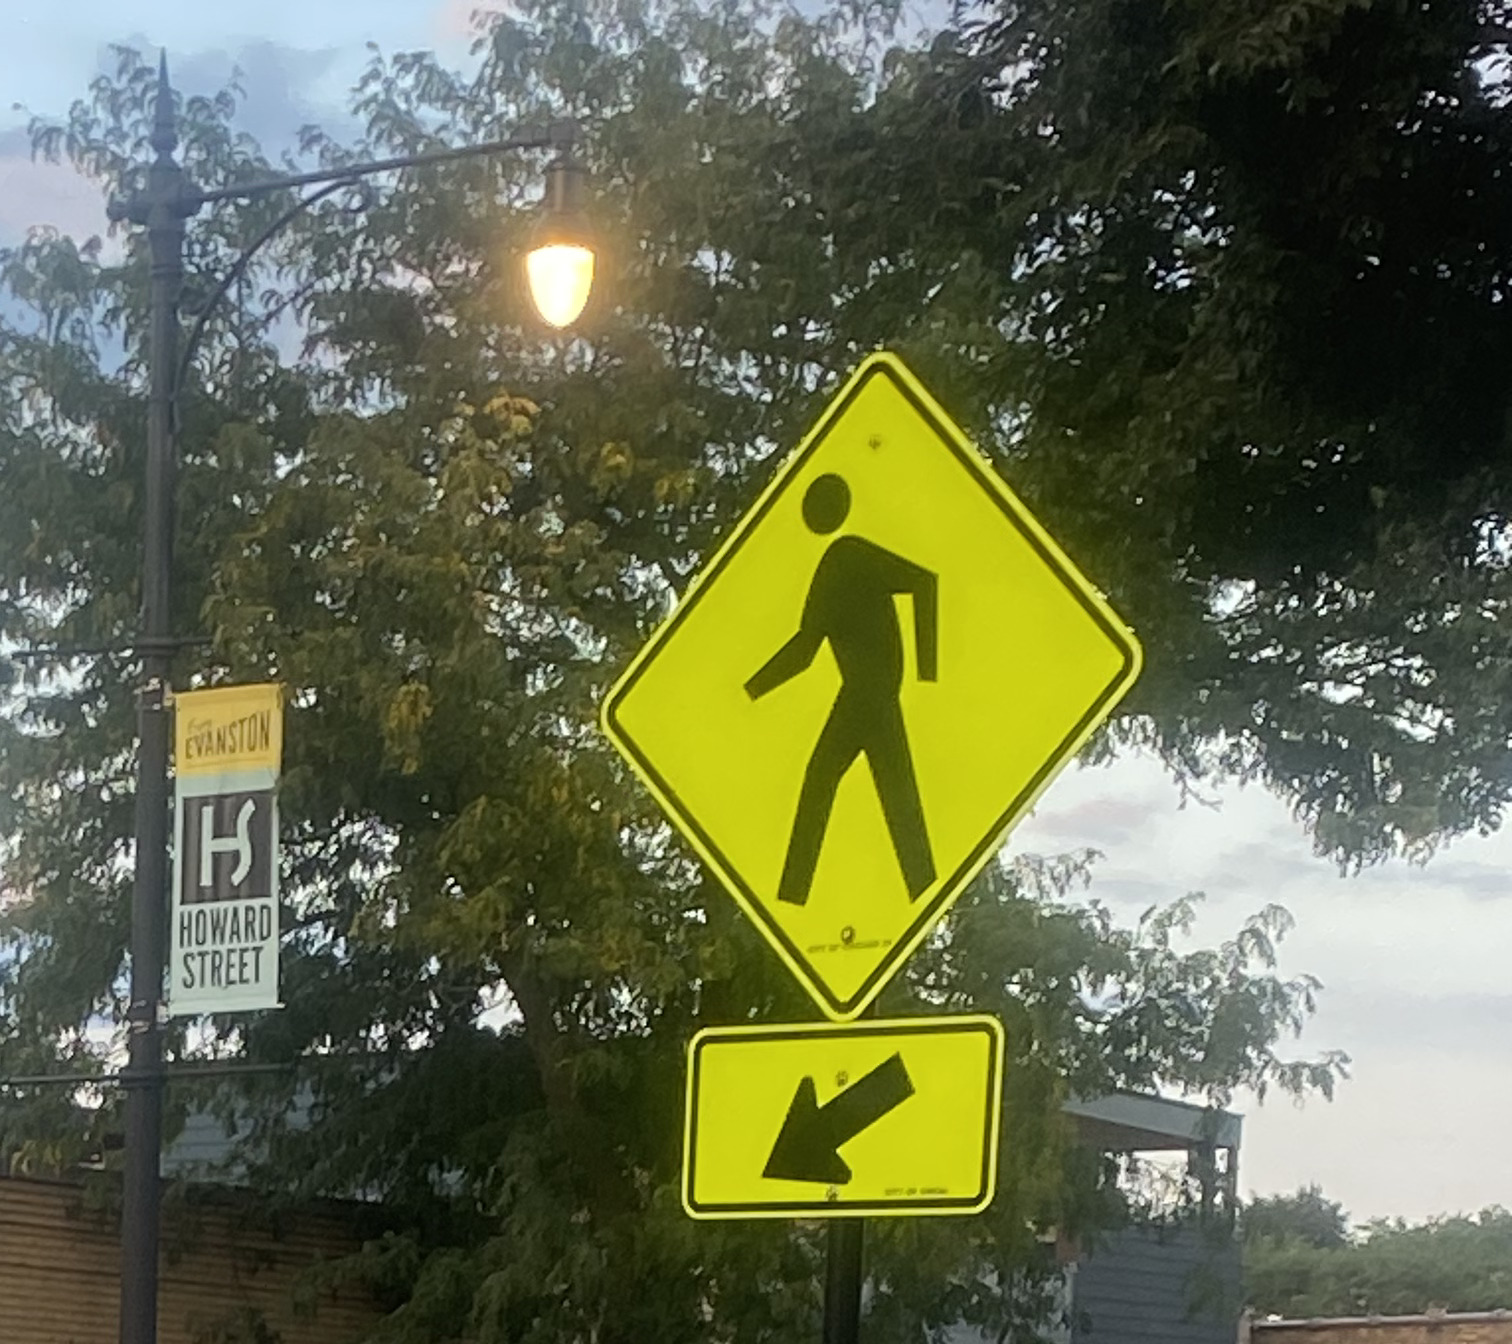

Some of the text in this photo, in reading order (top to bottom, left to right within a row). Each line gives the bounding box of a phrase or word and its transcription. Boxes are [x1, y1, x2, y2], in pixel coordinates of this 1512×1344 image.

[185, 709, 271, 760] EVANSTON
[179, 904, 272, 949] HOWARD
[182, 946, 265, 990] STREET
